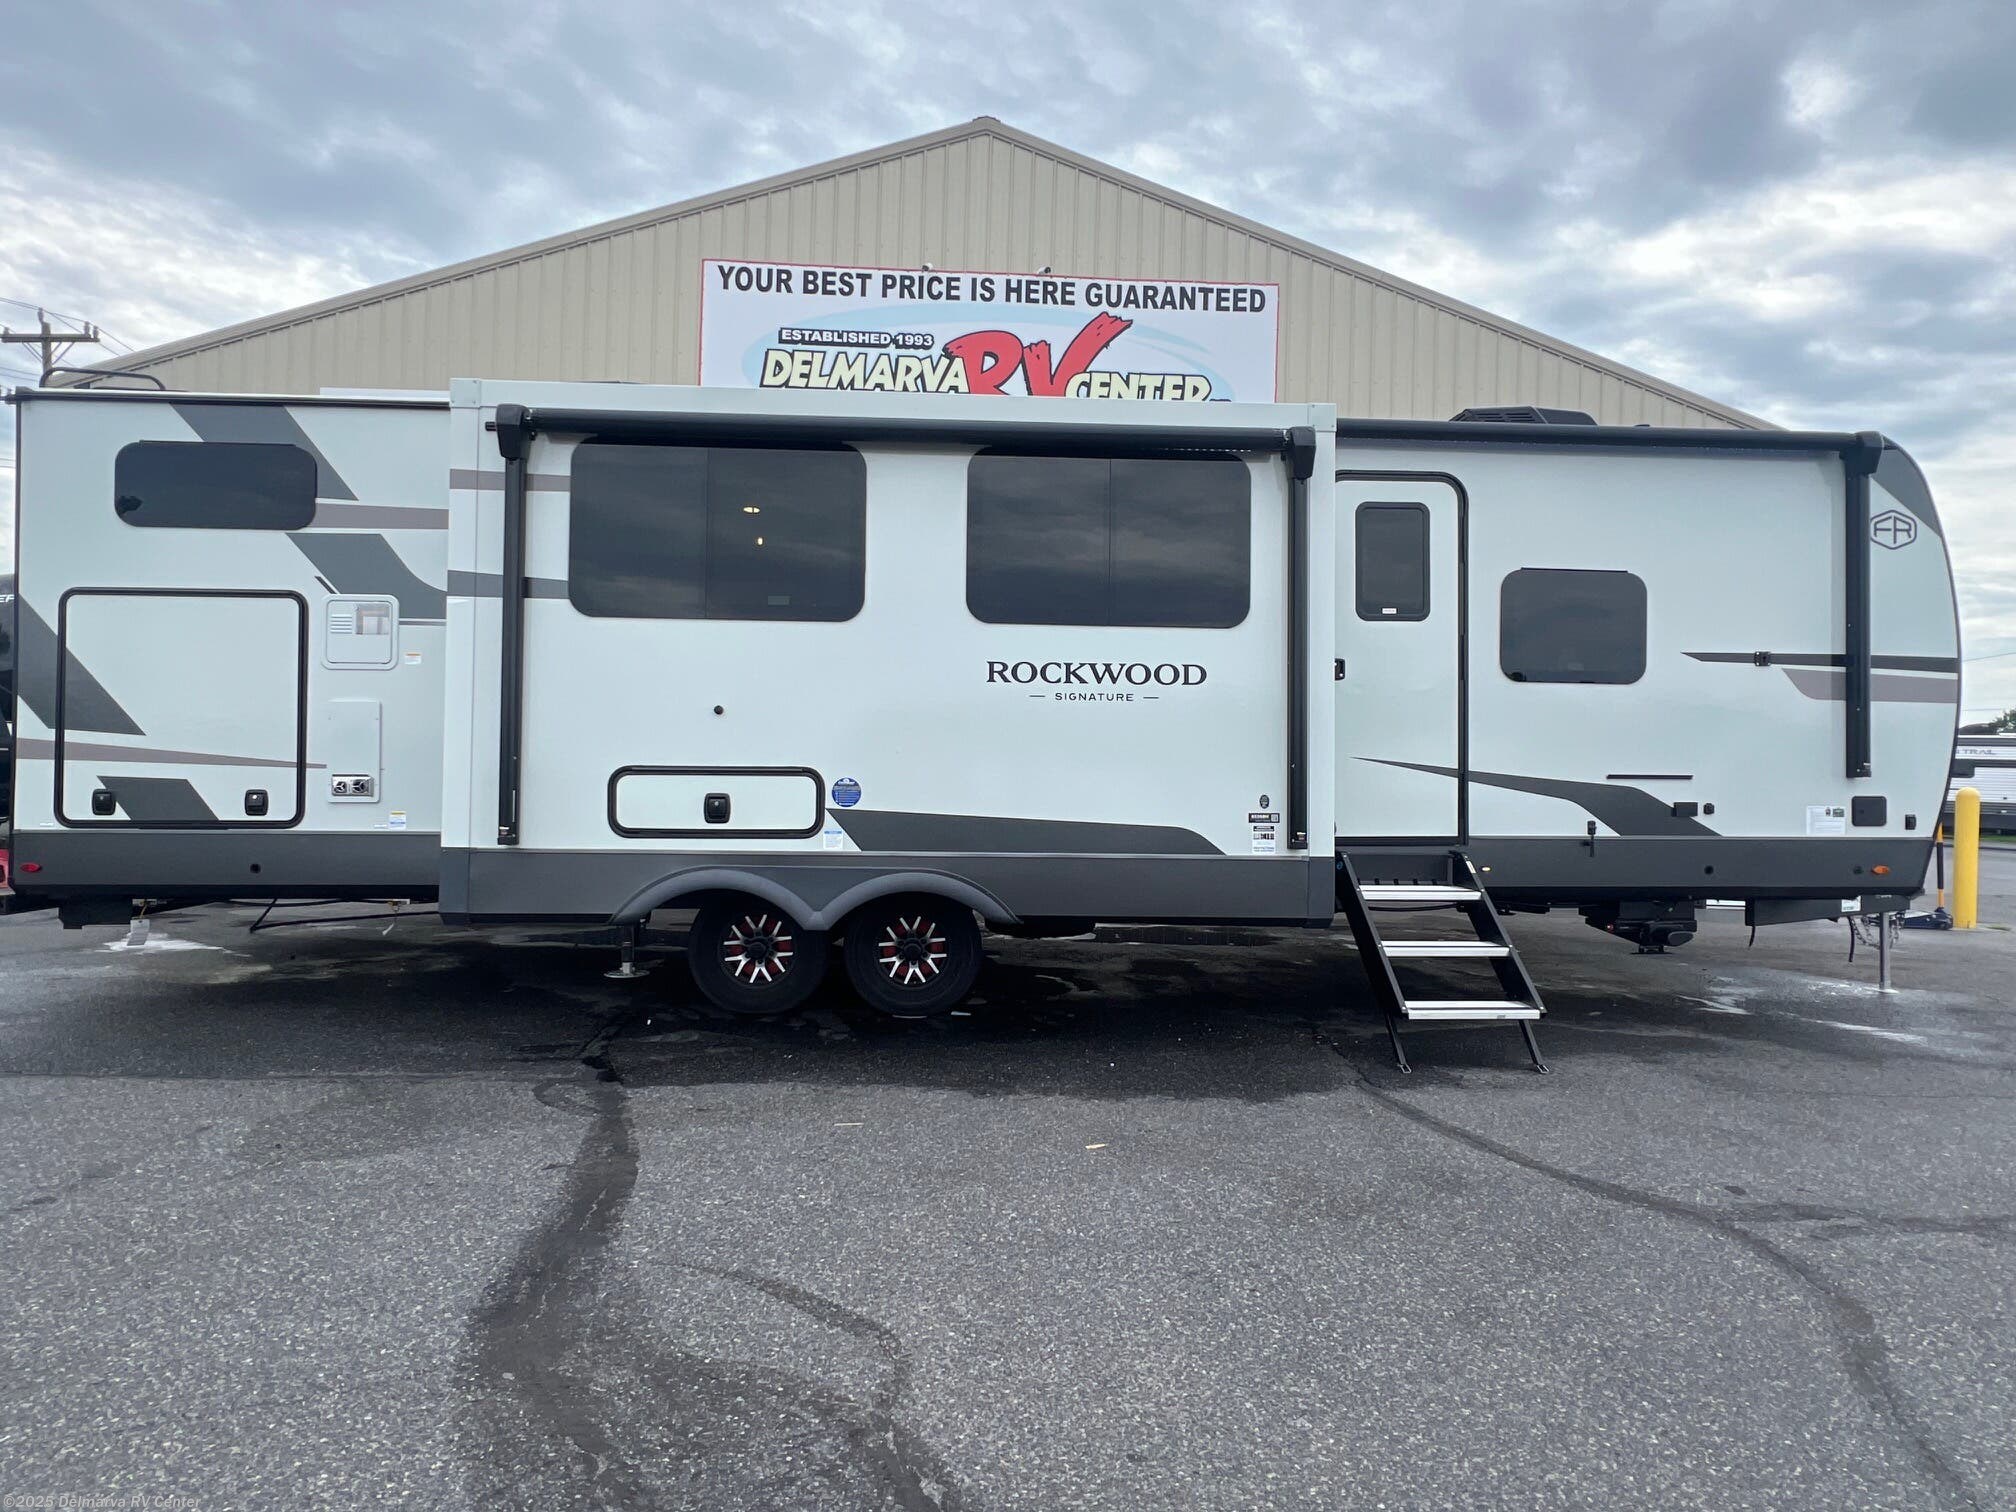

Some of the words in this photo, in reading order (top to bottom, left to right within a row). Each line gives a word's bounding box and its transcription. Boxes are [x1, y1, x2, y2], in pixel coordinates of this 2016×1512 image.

[718, 265, 793, 293] YOUR
[803, 270, 872, 297] BEST
[881, 274, 961, 301] PRICE
[971, 277, 995, 302] IS
[1005, 278, 1075, 306] HERE
[1085, 282, 1266, 313] GUARANTEED
[780, 328, 892, 345] ESTABLISHED
[896, 333, 934, 347] 1993
[760, 349, 971, 394] DELMARVA
[943, 311, 1133, 396] RV
[986, 661, 1208, 686] ROCKWOOD
[1055, 692, 1134, 702] SIGNATURE
